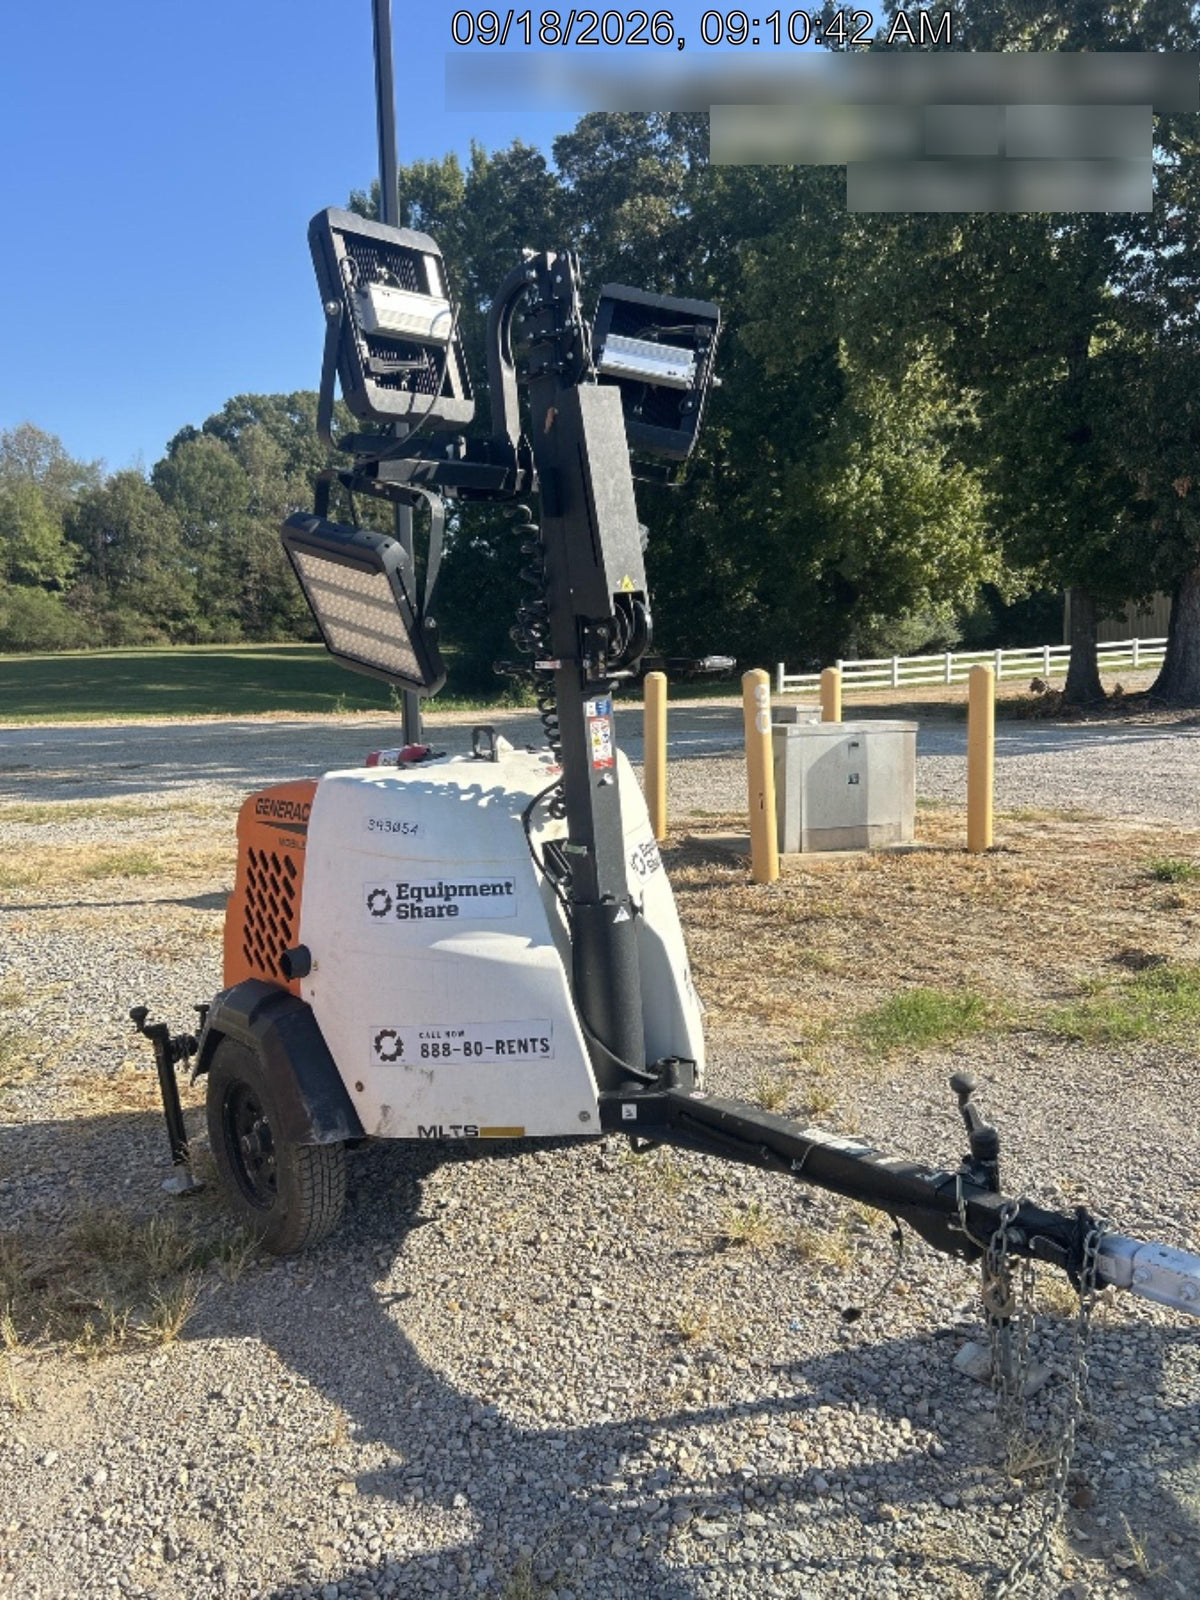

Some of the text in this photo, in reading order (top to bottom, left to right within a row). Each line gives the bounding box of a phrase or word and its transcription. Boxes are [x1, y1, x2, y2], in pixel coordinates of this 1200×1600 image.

[396, 881, 514, 902] Equipment
[396, 902, 460, 920] Share
[420, 1038, 551, 1059] 888-80-RENTS
